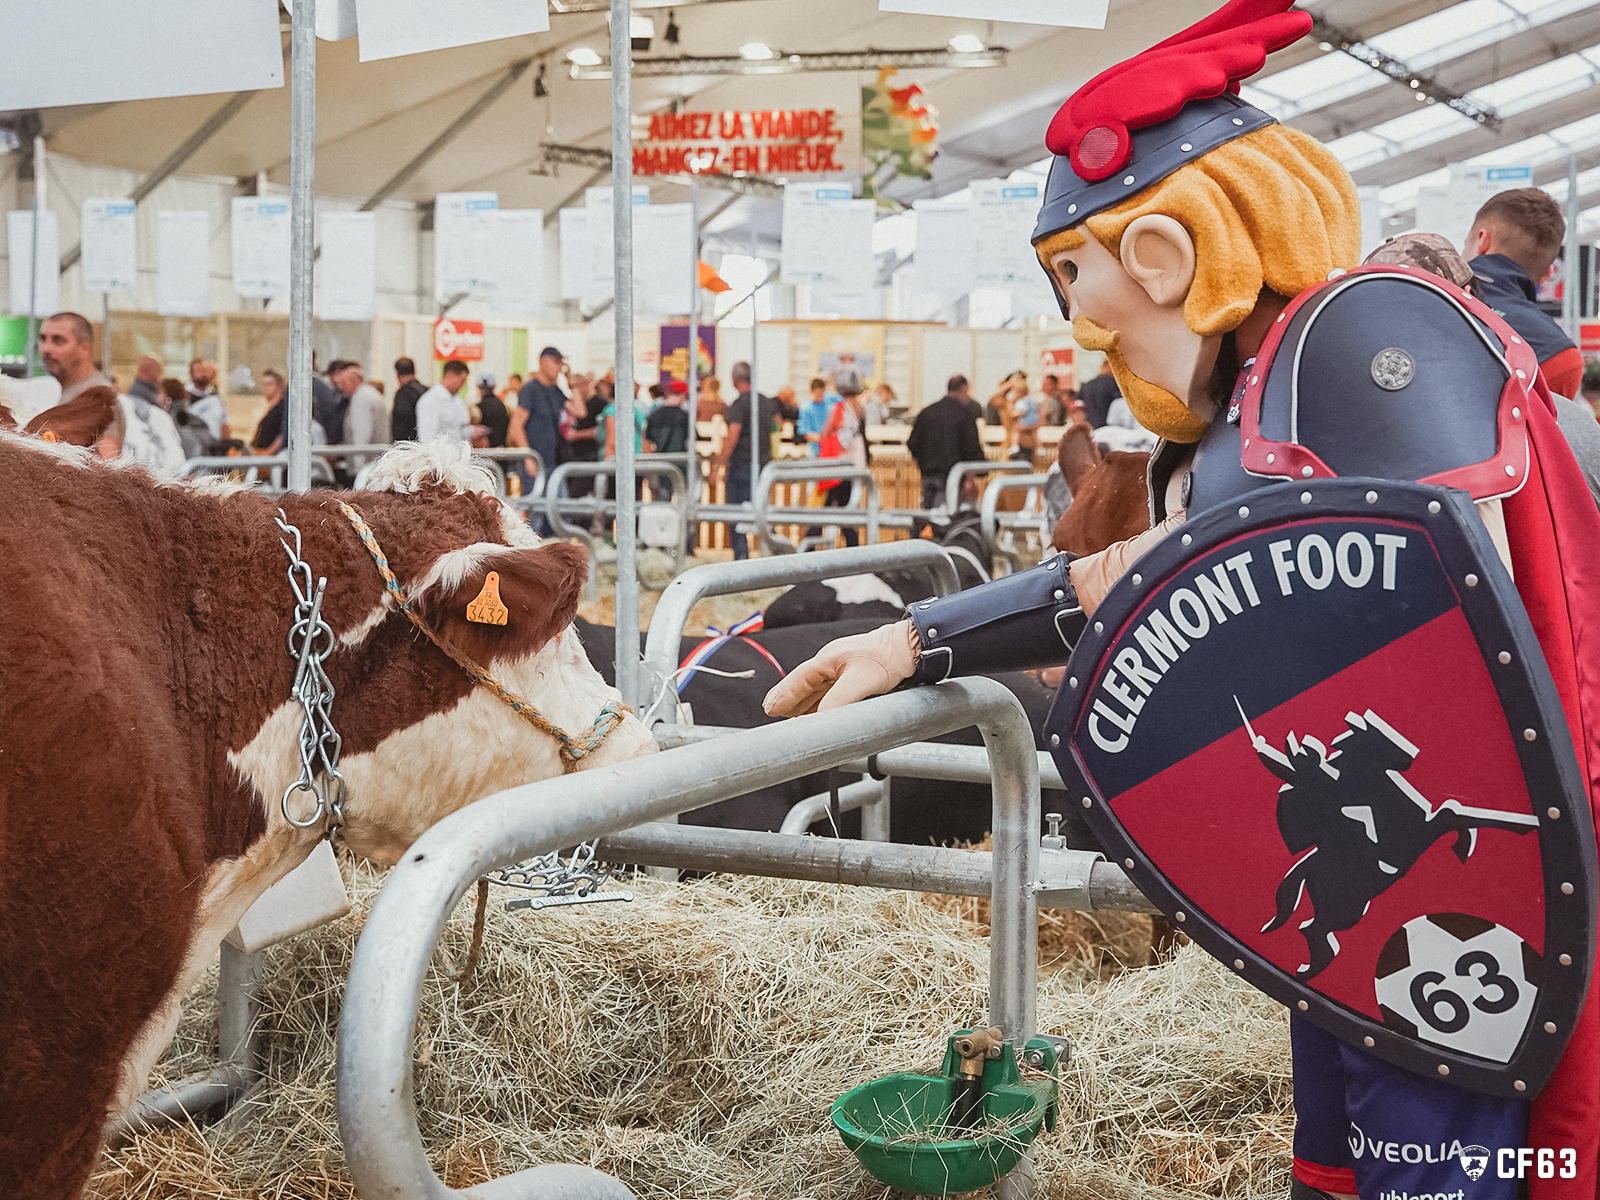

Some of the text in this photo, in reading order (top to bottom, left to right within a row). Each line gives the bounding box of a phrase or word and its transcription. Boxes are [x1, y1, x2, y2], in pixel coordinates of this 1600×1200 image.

[650, 109, 844, 144] AIMEZ LA VIANDE,
[767, 144, 844, 172] MIEUX.
[469, 605, 504, 624] 3432
[1088, 531, 1407, 753] CLERMONT FOOT
[1410, 950, 1520, 1034] 63
[1367, 1139, 1463, 1164] VEOLIA
